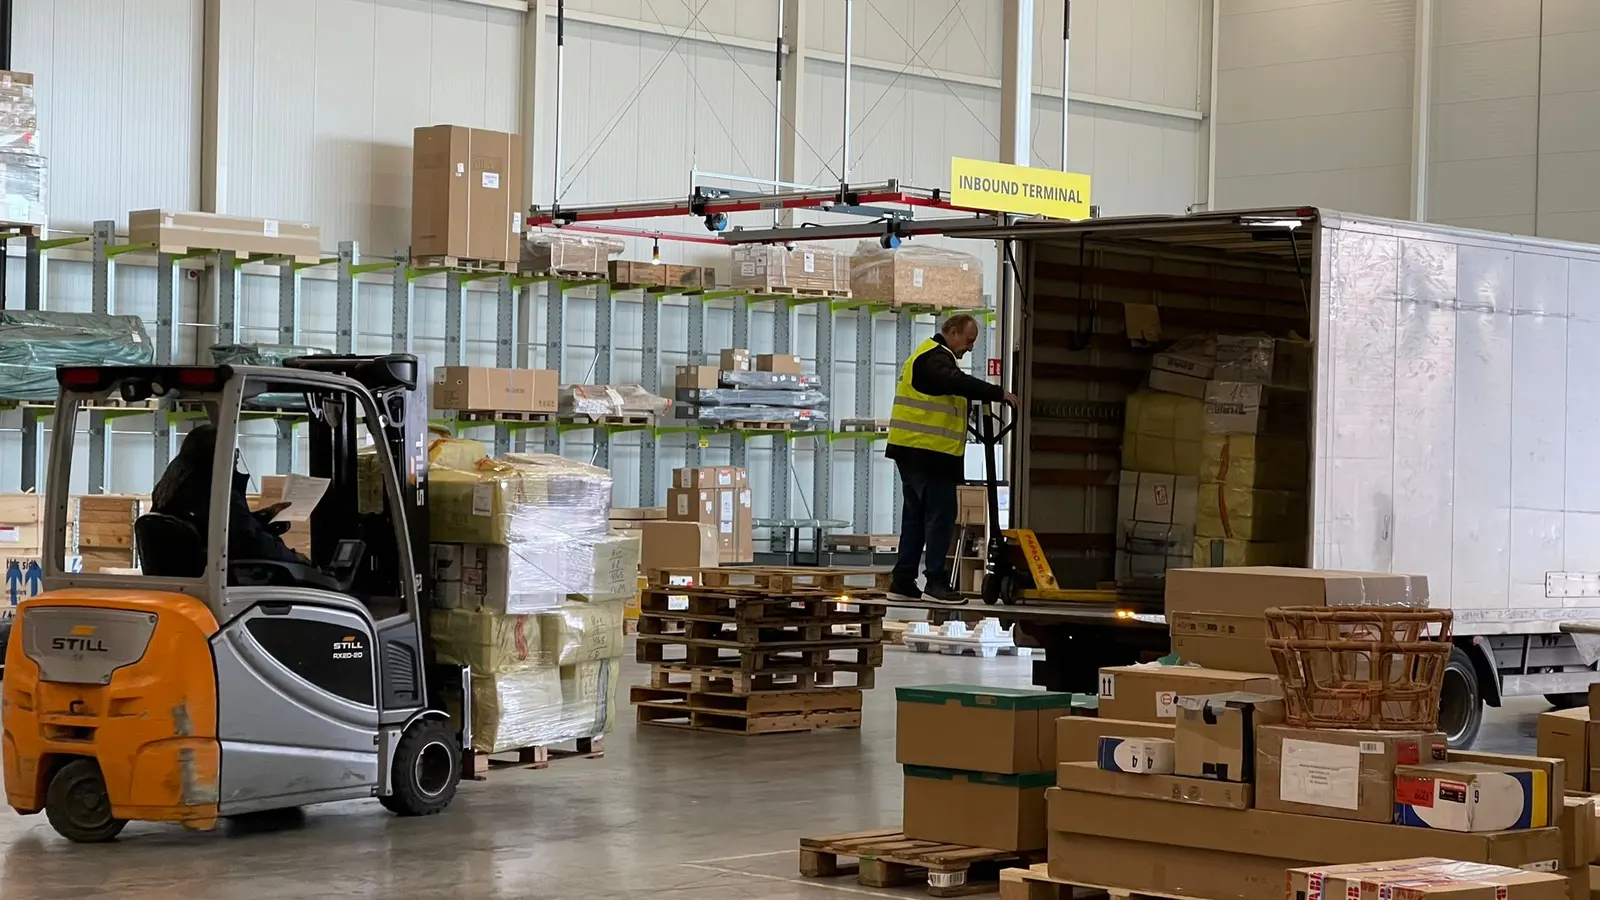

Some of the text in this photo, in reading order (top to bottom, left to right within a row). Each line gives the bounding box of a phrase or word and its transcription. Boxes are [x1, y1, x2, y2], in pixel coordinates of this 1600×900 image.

[959, 175, 1082, 203] INBOUND TERMINAL
[416, 433, 424, 506] STILL
[52, 637, 108, 652] STILL
[333, 641, 363, 650] STILL
